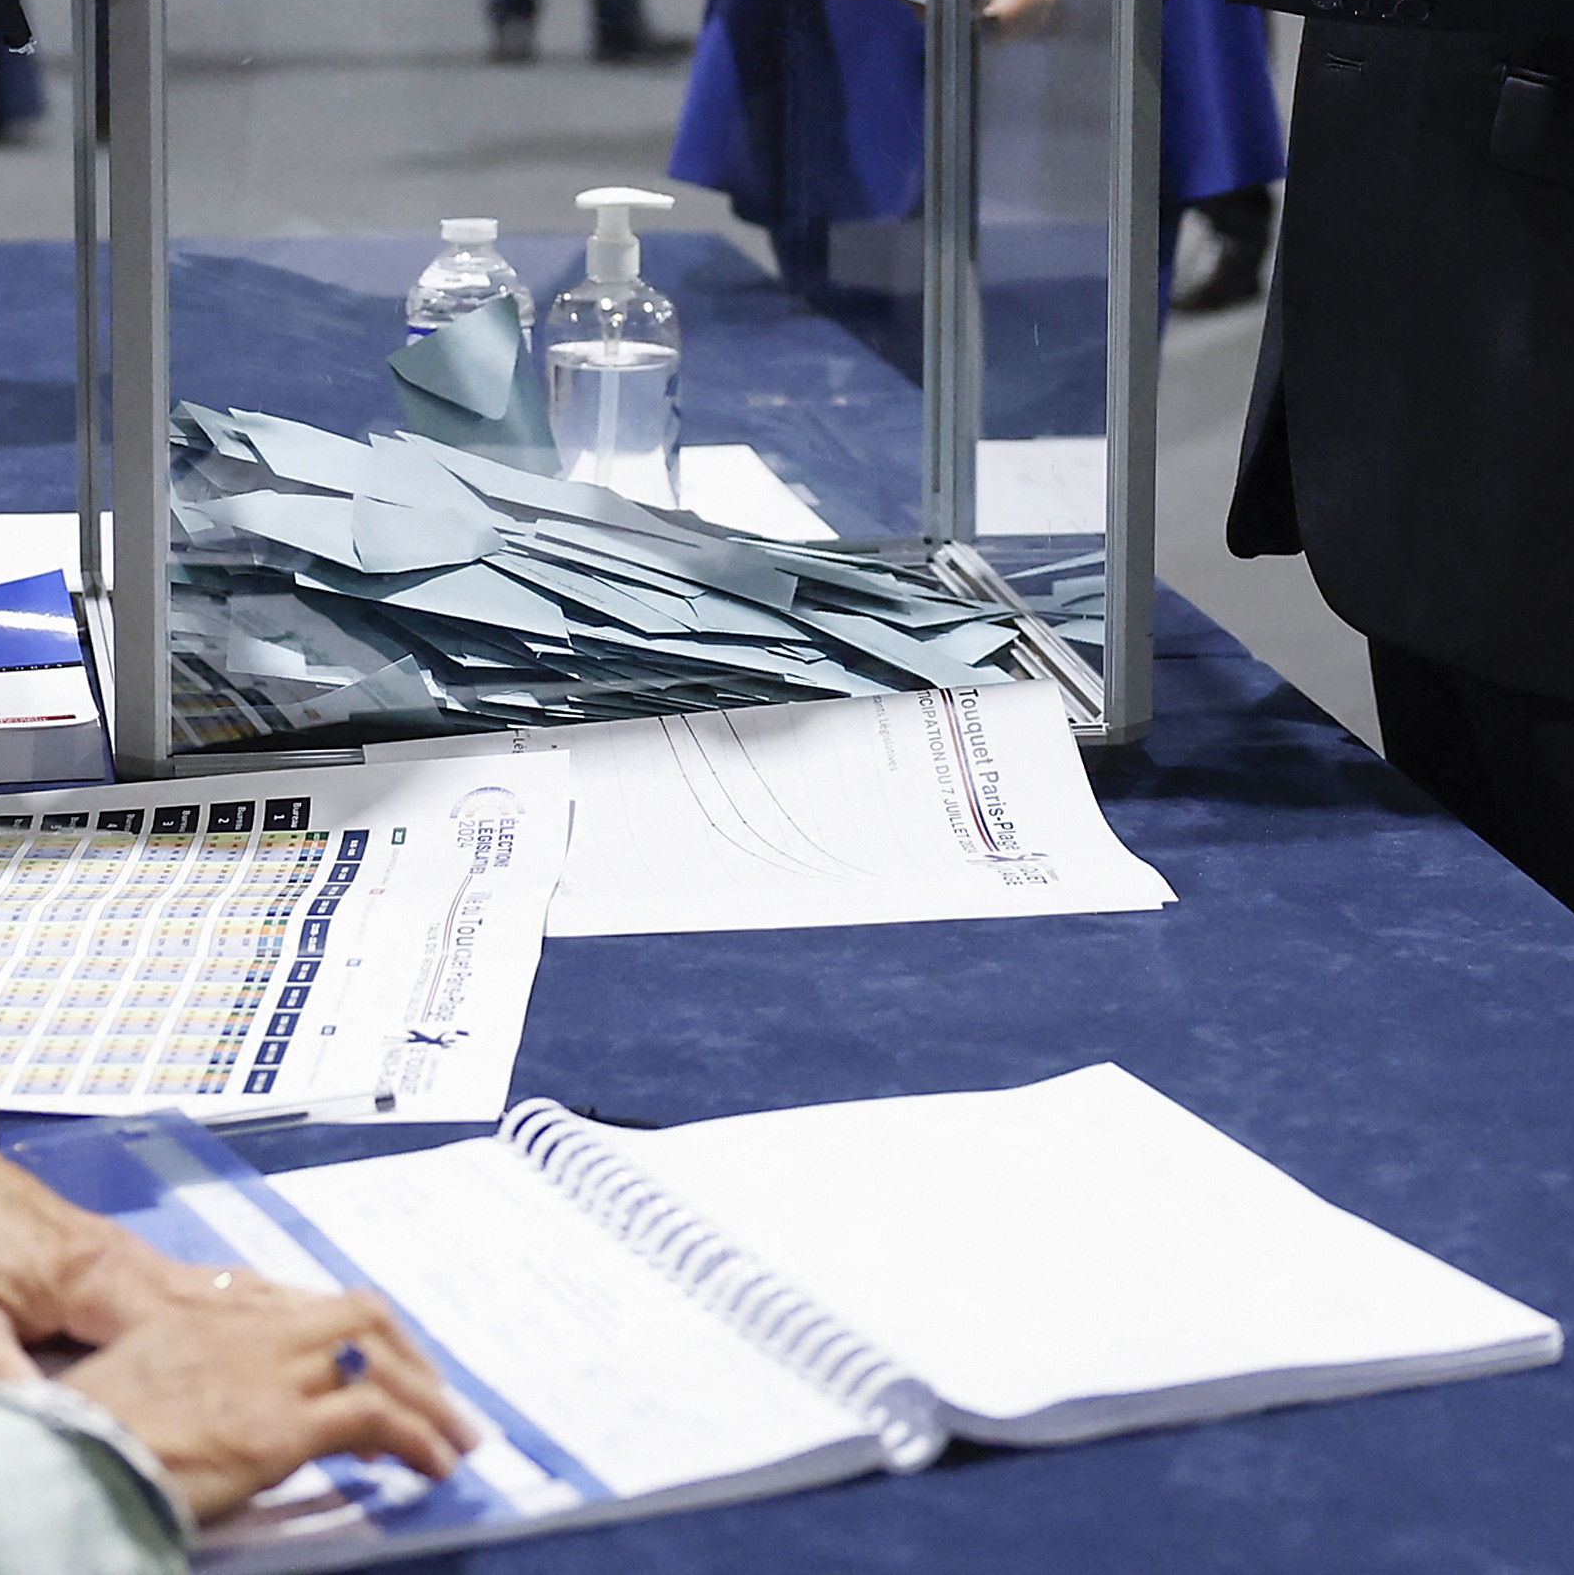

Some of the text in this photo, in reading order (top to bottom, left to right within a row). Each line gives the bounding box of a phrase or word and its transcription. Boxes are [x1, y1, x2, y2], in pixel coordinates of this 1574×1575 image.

[935, 764, 953, 785] DU
[957, 688, 994, 765] Touquet
[978, 770, 1021, 851] Paris-Plage
[456, 819, 476, 849] 2024
[943, 797, 971, 841] JUILLET
